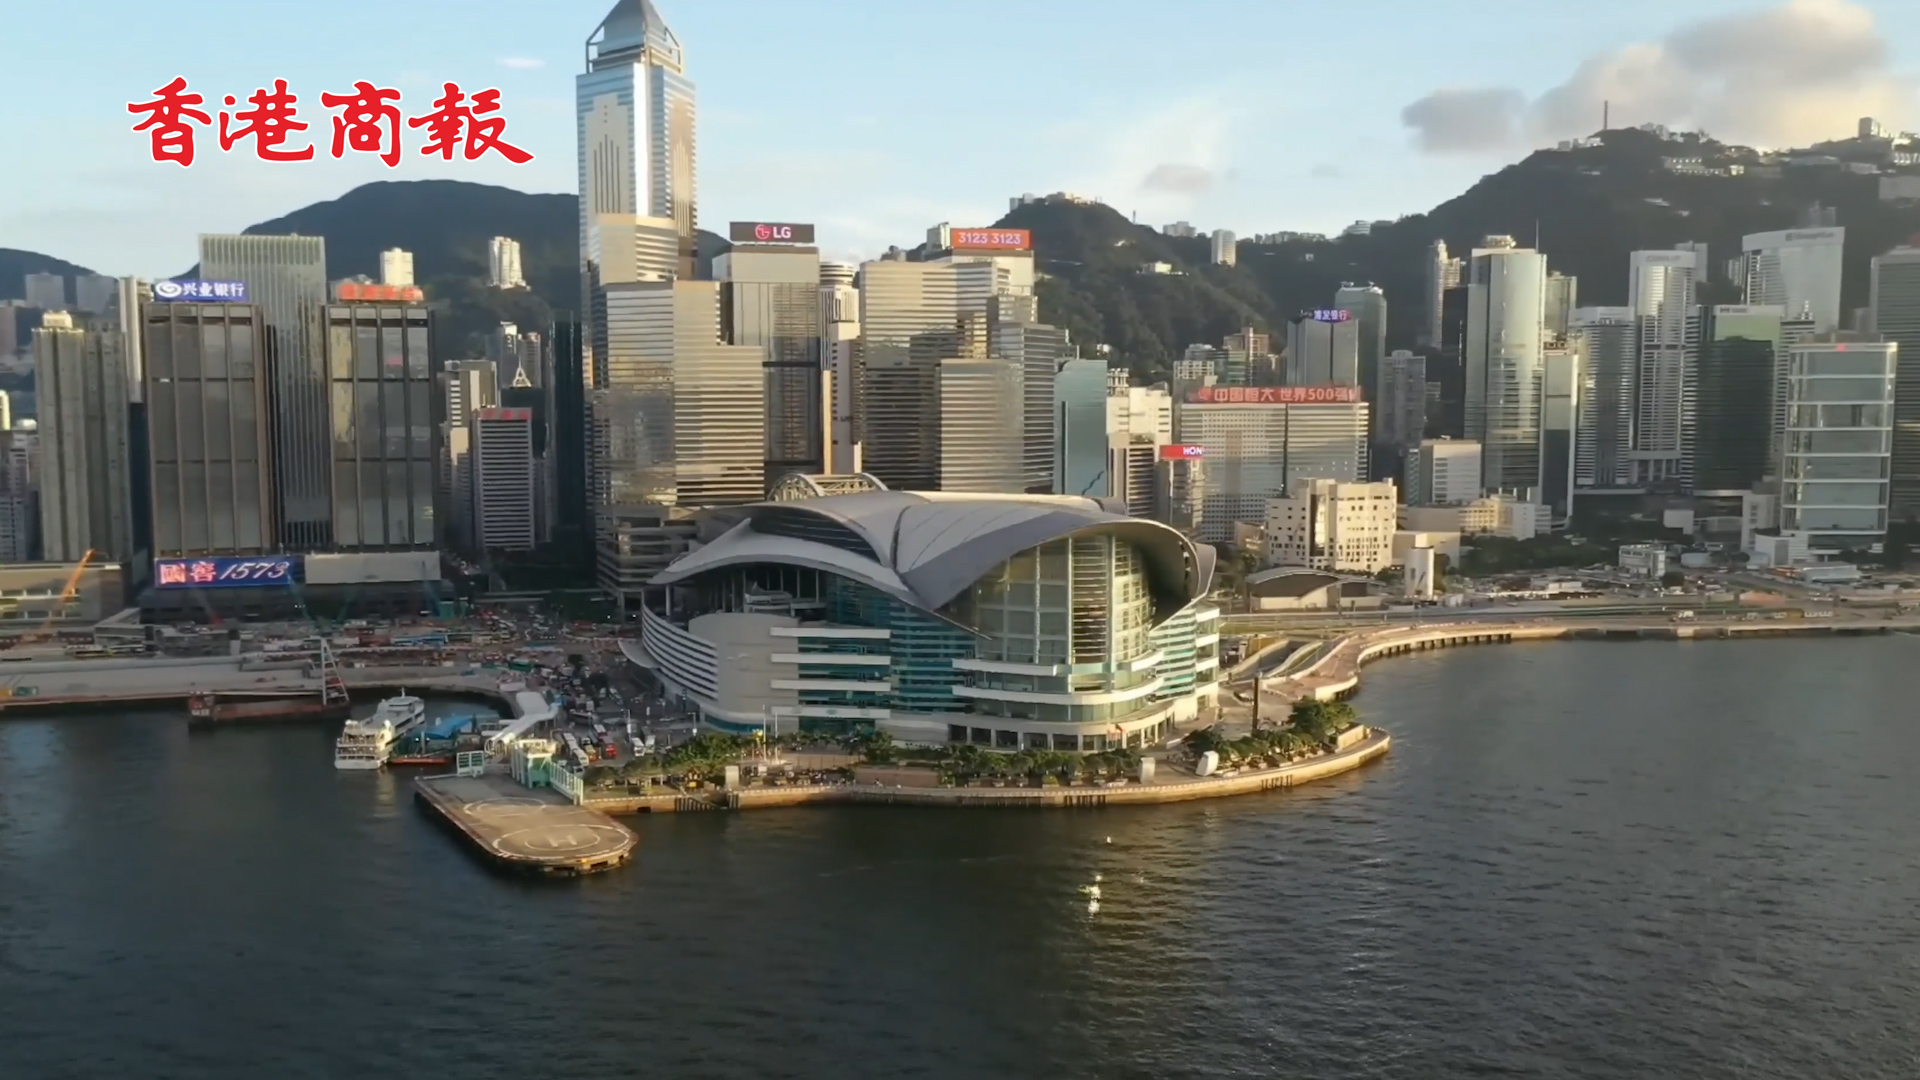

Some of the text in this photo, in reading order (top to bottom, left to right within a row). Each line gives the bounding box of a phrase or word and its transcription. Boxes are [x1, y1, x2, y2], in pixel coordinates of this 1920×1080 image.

[773, 226, 792, 239] LG
[958, 233, 1022, 246] 3123 3123
[183, 282, 245, 298] 兴业银行
[1214, 387, 1275, 403] 中国恒大
